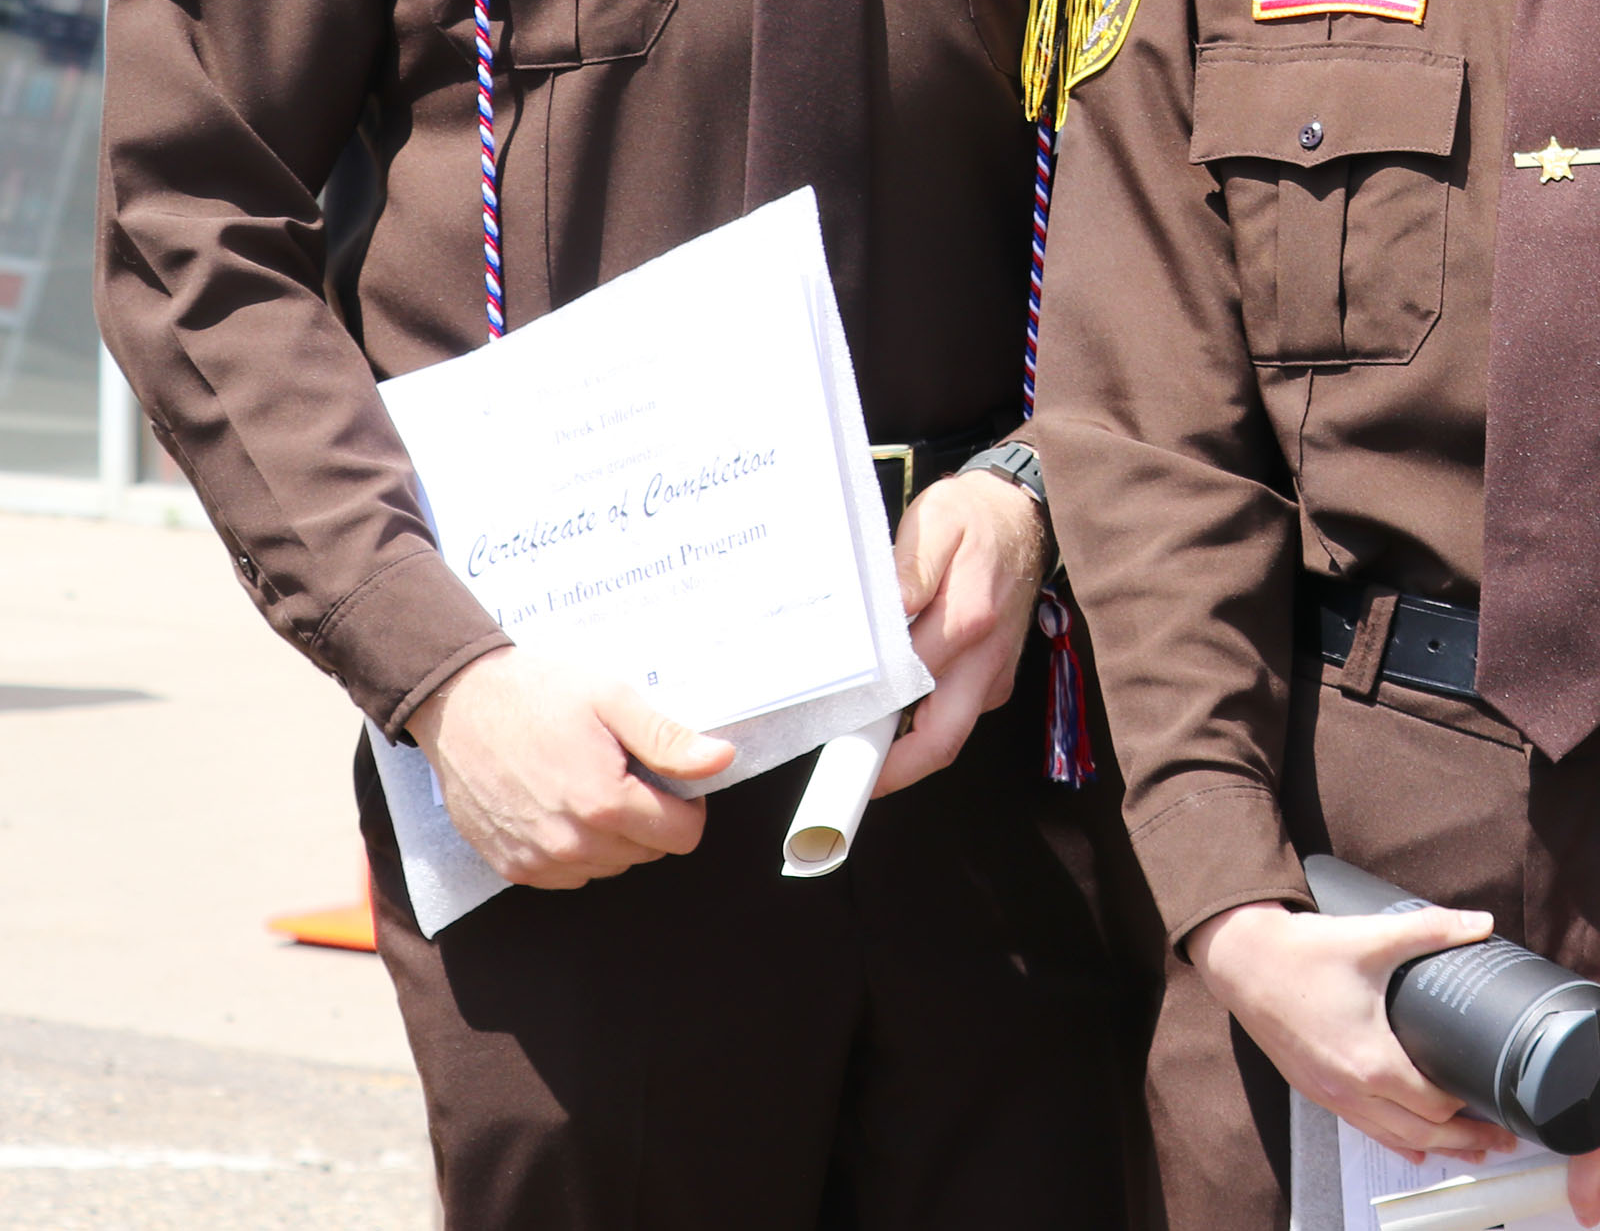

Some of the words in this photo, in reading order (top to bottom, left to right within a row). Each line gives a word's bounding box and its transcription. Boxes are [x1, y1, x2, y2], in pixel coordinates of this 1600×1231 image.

[467, 509, 596, 578] Certificate
[607, 488, 630, 533] of
[643, 448, 776, 518] Completion
[547, 554, 674, 612] Enforcement
[679, 523, 768, 567] Program
